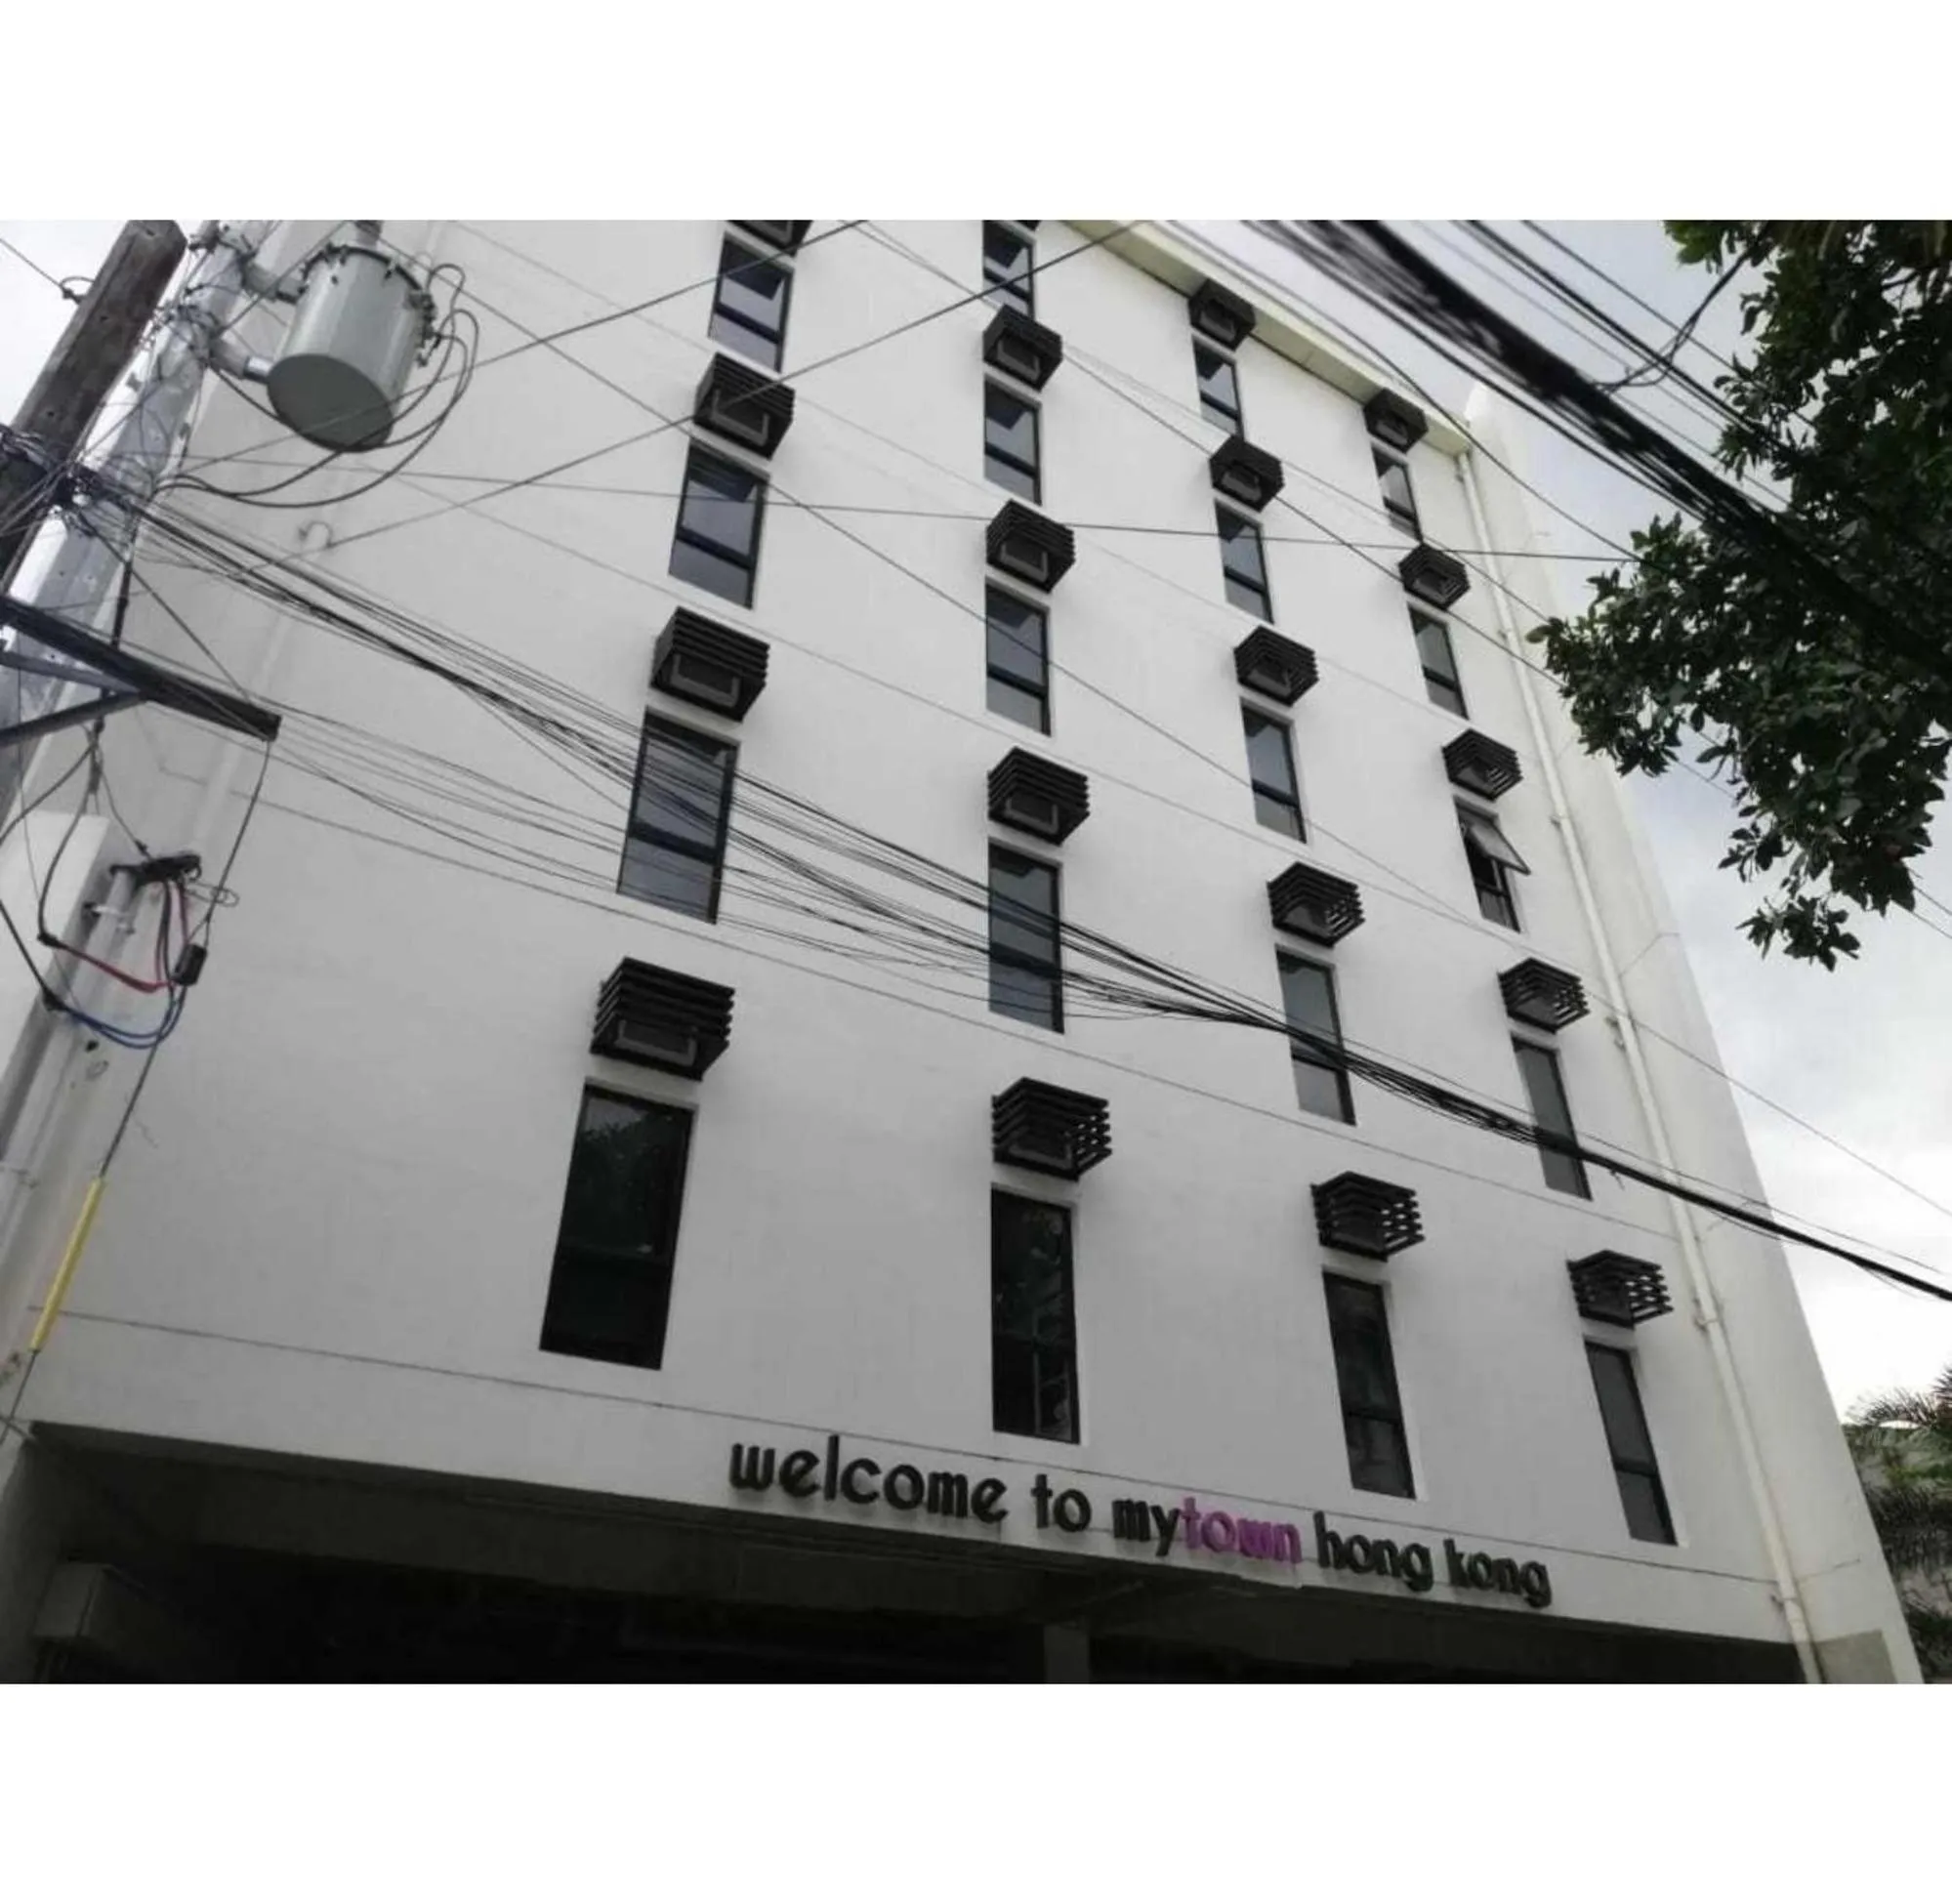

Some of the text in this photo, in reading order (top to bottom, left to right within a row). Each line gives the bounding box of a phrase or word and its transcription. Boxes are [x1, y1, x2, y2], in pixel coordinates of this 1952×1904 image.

[729, 1434, 1552, 1608] welcome to mytown hong kong
